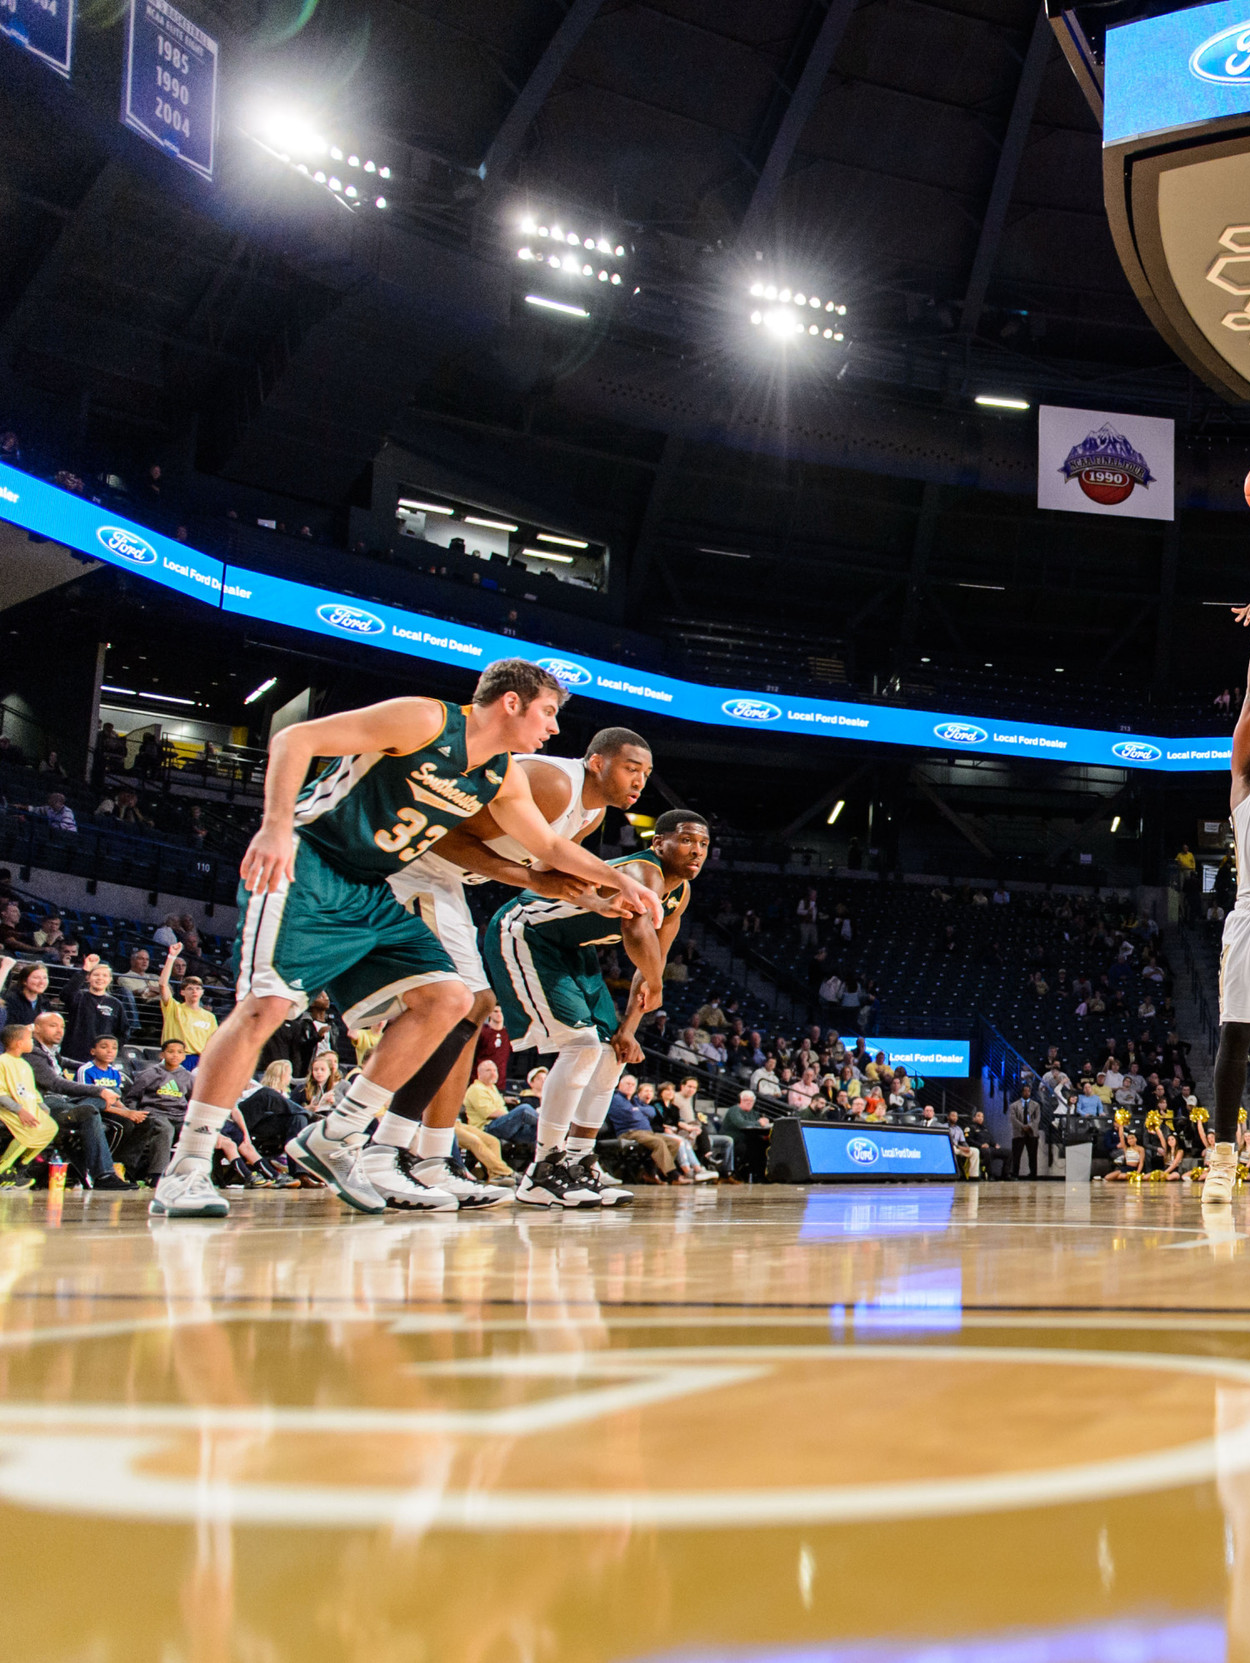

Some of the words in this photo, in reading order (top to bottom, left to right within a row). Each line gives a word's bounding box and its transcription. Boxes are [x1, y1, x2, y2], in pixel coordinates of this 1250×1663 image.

[157, 35, 190, 75] 1985
[156, 65, 189, 105] 1990
[155, 97, 190, 138] 2004
[1094, 456, 1121, 467] FINAL
[1089, 471, 1123, 484] 1990
[109, 531, 146, 561] Ford
[163, 556, 188, 578] Local
[190, 569, 211, 586] Ford
[212, 576, 252, 599] Dealer
[329, 606, 372, 632] Ford
[392, 625, 422, 642] Local
[423, 632, 448, 649] Ford
[449, 639, 483, 657] Dealer
[597, 676, 622, 691] Local
[623, 682, 644, 696] Ford
[644, 687, 673, 702] Dealer
[733, 701, 770, 720] Ford
[788, 710, 815, 722] Local
[815, 714, 838, 724] Ford
[838, 716, 870, 727] Dealer
[944, 725, 977, 742] Ford
[993, 733, 1018, 744] Local
[1019, 736, 1039, 746] Ford
[1039, 738, 1067, 748] Dealer
[1121, 744, 1151, 760] Ford
[1167, 751, 1190, 760] Local
[1191, 750, 1211, 759] Ford
[196, 862, 211, 873] 110
[889, 1053, 913, 1062] Local
[914, 1053, 934, 1063] Ford
[935, 1053, 964, 1064] Dealer
[853, 1141, 873, 1161] Ford
[882, 1147, 895, 1158] Local
[895, 1148, 907, 1158] Ford
[907, 1149, 921, 1159] Dealer
